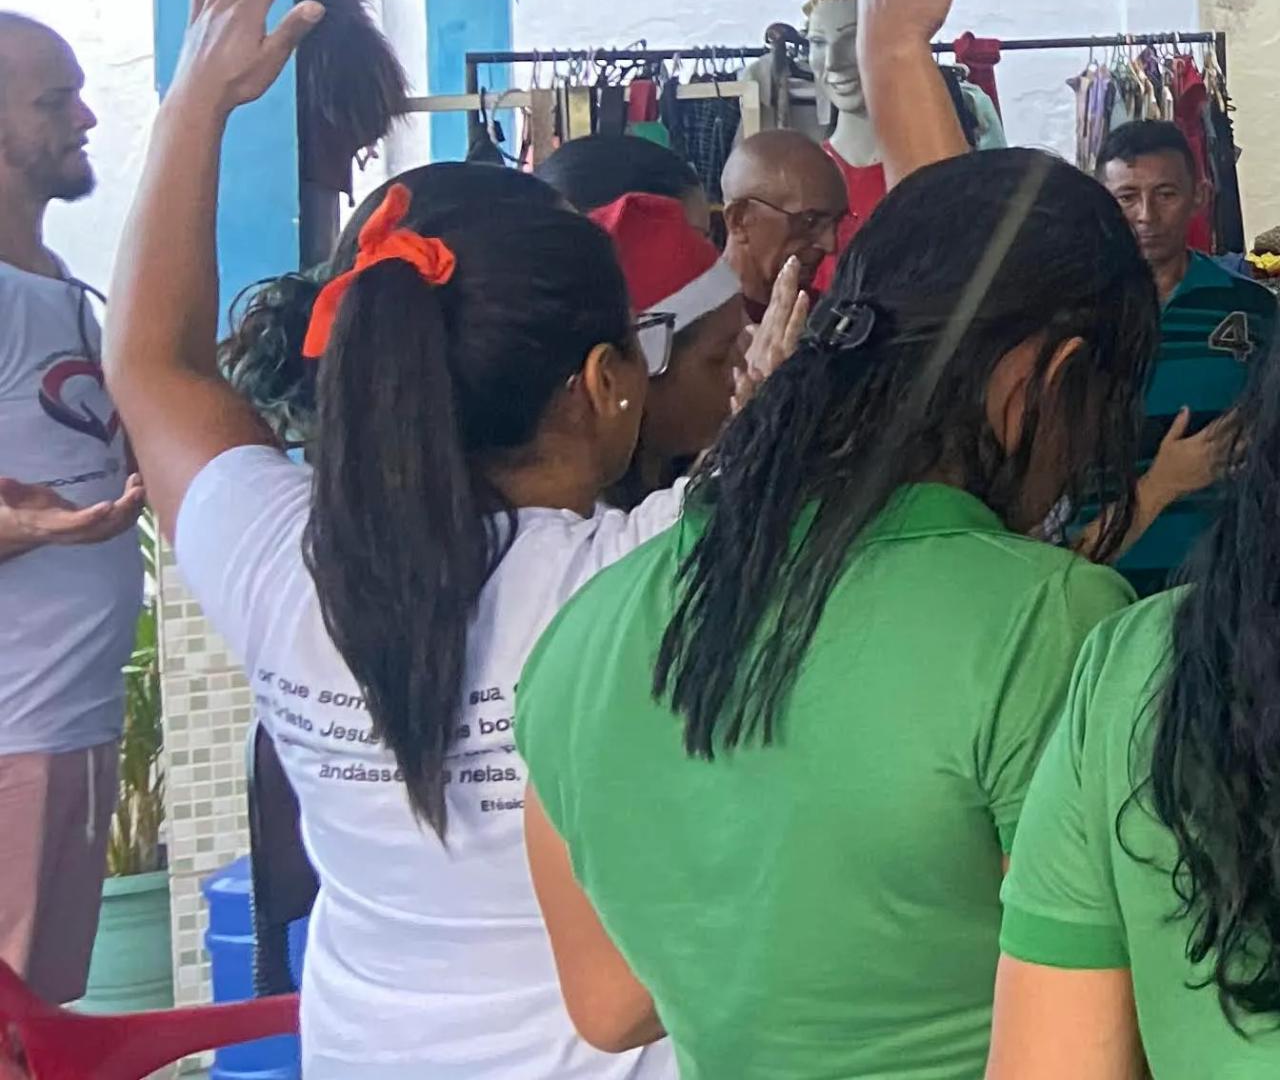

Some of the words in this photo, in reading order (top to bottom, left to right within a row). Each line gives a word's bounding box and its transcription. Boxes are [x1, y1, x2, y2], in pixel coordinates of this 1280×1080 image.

[1208, 311, 1253, 361] 4
[278, 678, 309, 698] que
[317, 690, 368, 711] som
